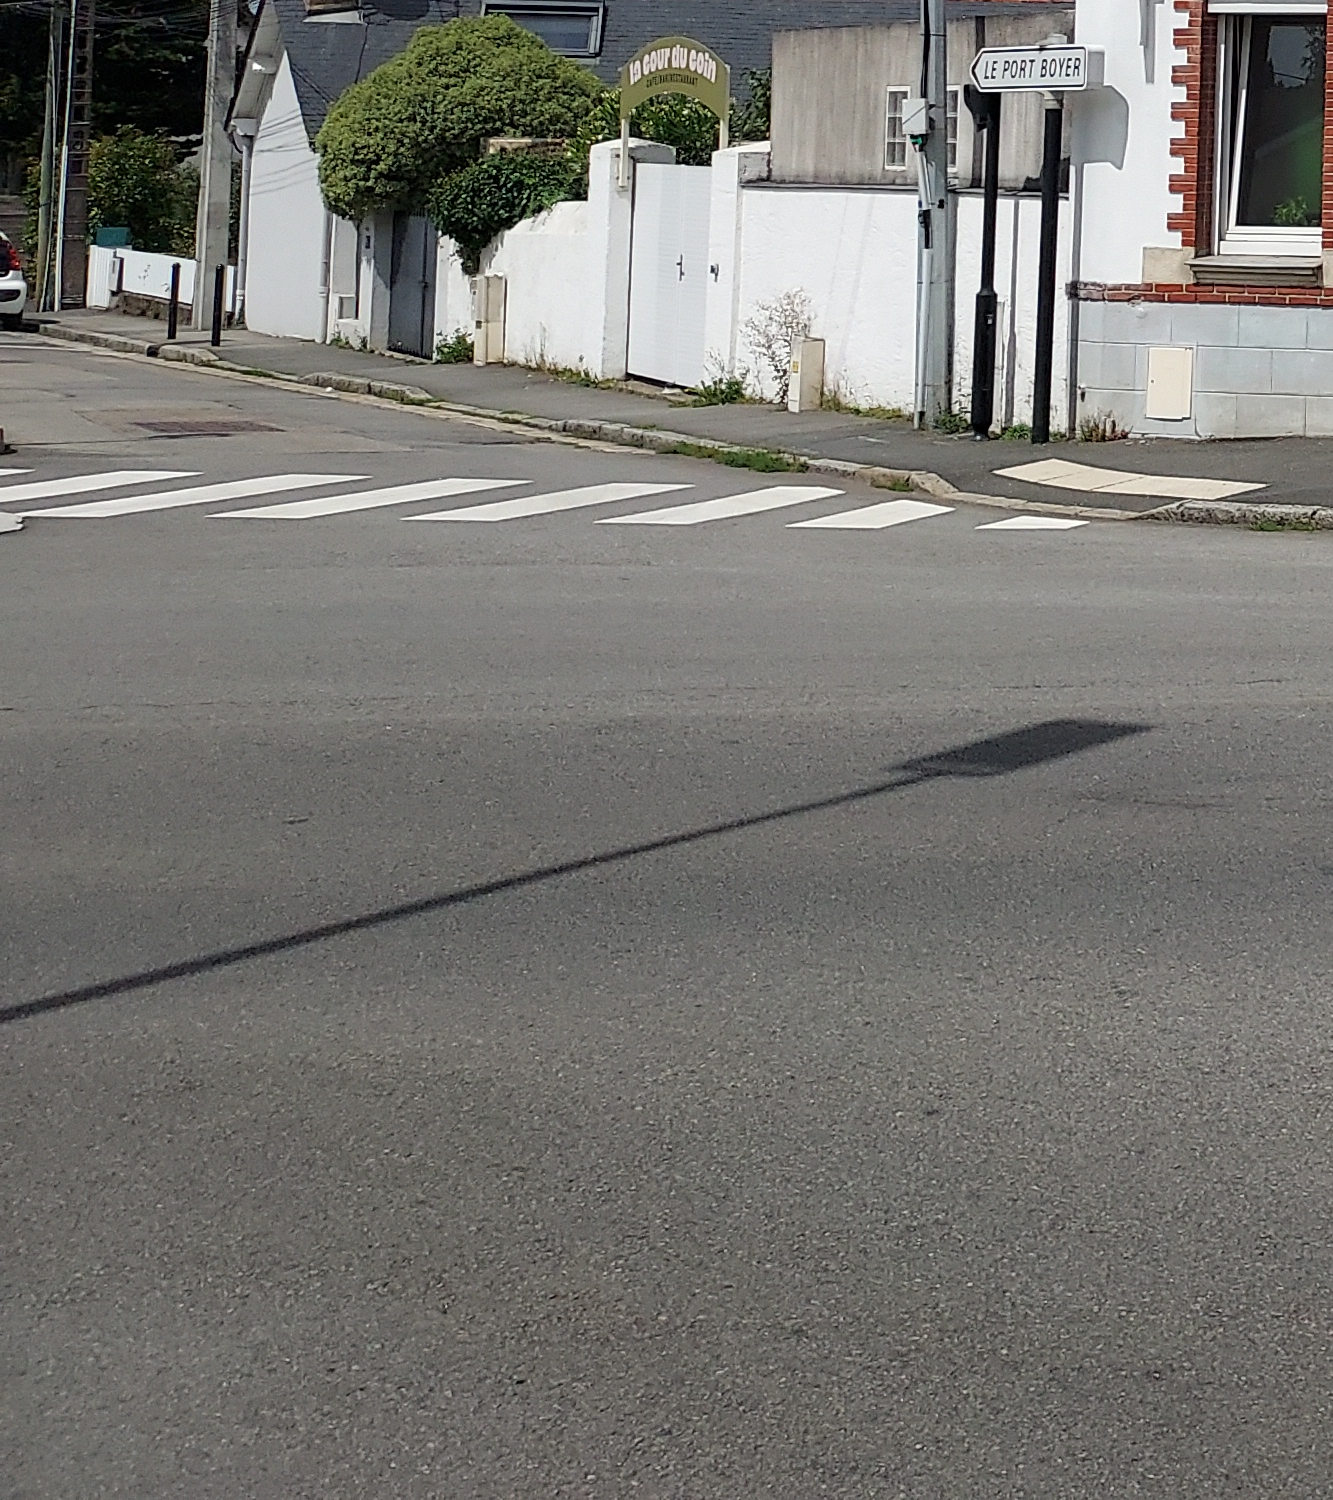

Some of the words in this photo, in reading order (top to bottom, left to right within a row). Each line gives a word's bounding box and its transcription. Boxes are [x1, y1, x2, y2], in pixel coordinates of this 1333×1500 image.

[629, 59, 642, 86] la
[642, 47, 670, 76] cour
[671, 44, 688, 69] du
[688, 49, 717, 84] coin
[984, 60, 998, 80] LE
[1001, 59, 1036, 79] PORT
[1040, 57, 1081, 78] BOYER
